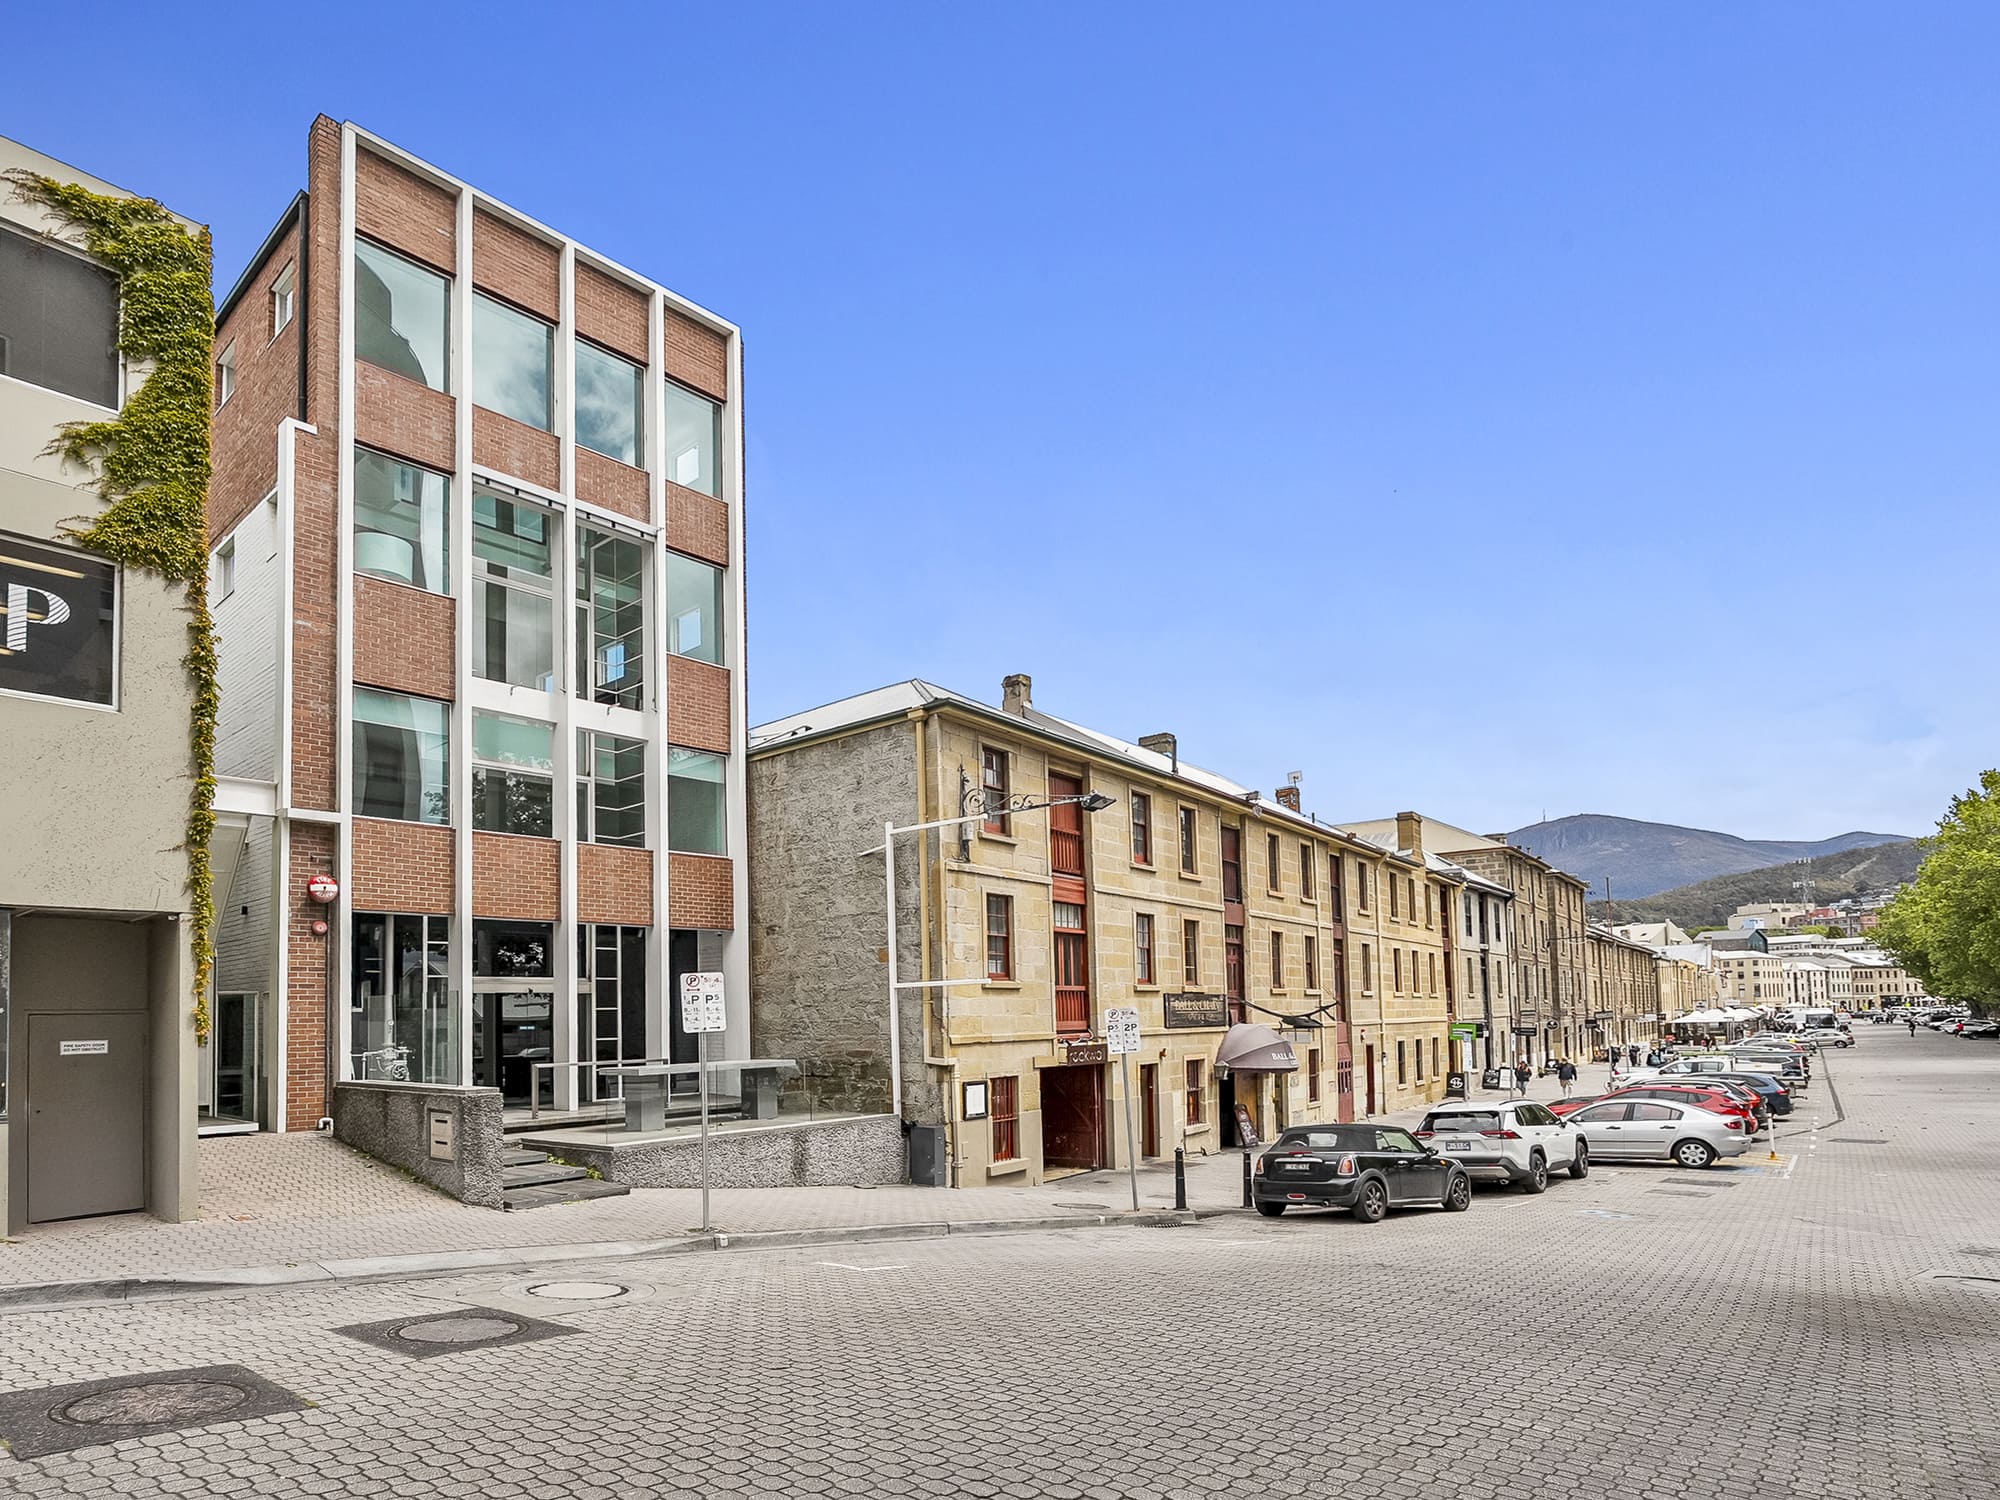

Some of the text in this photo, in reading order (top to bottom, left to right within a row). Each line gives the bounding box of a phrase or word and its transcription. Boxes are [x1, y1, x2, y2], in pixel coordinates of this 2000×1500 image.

[7, 582, 71, 653] P
[1124, 1023, 1138, 1031] 2P
[1271, 1052, 1289, 1061] BALL
